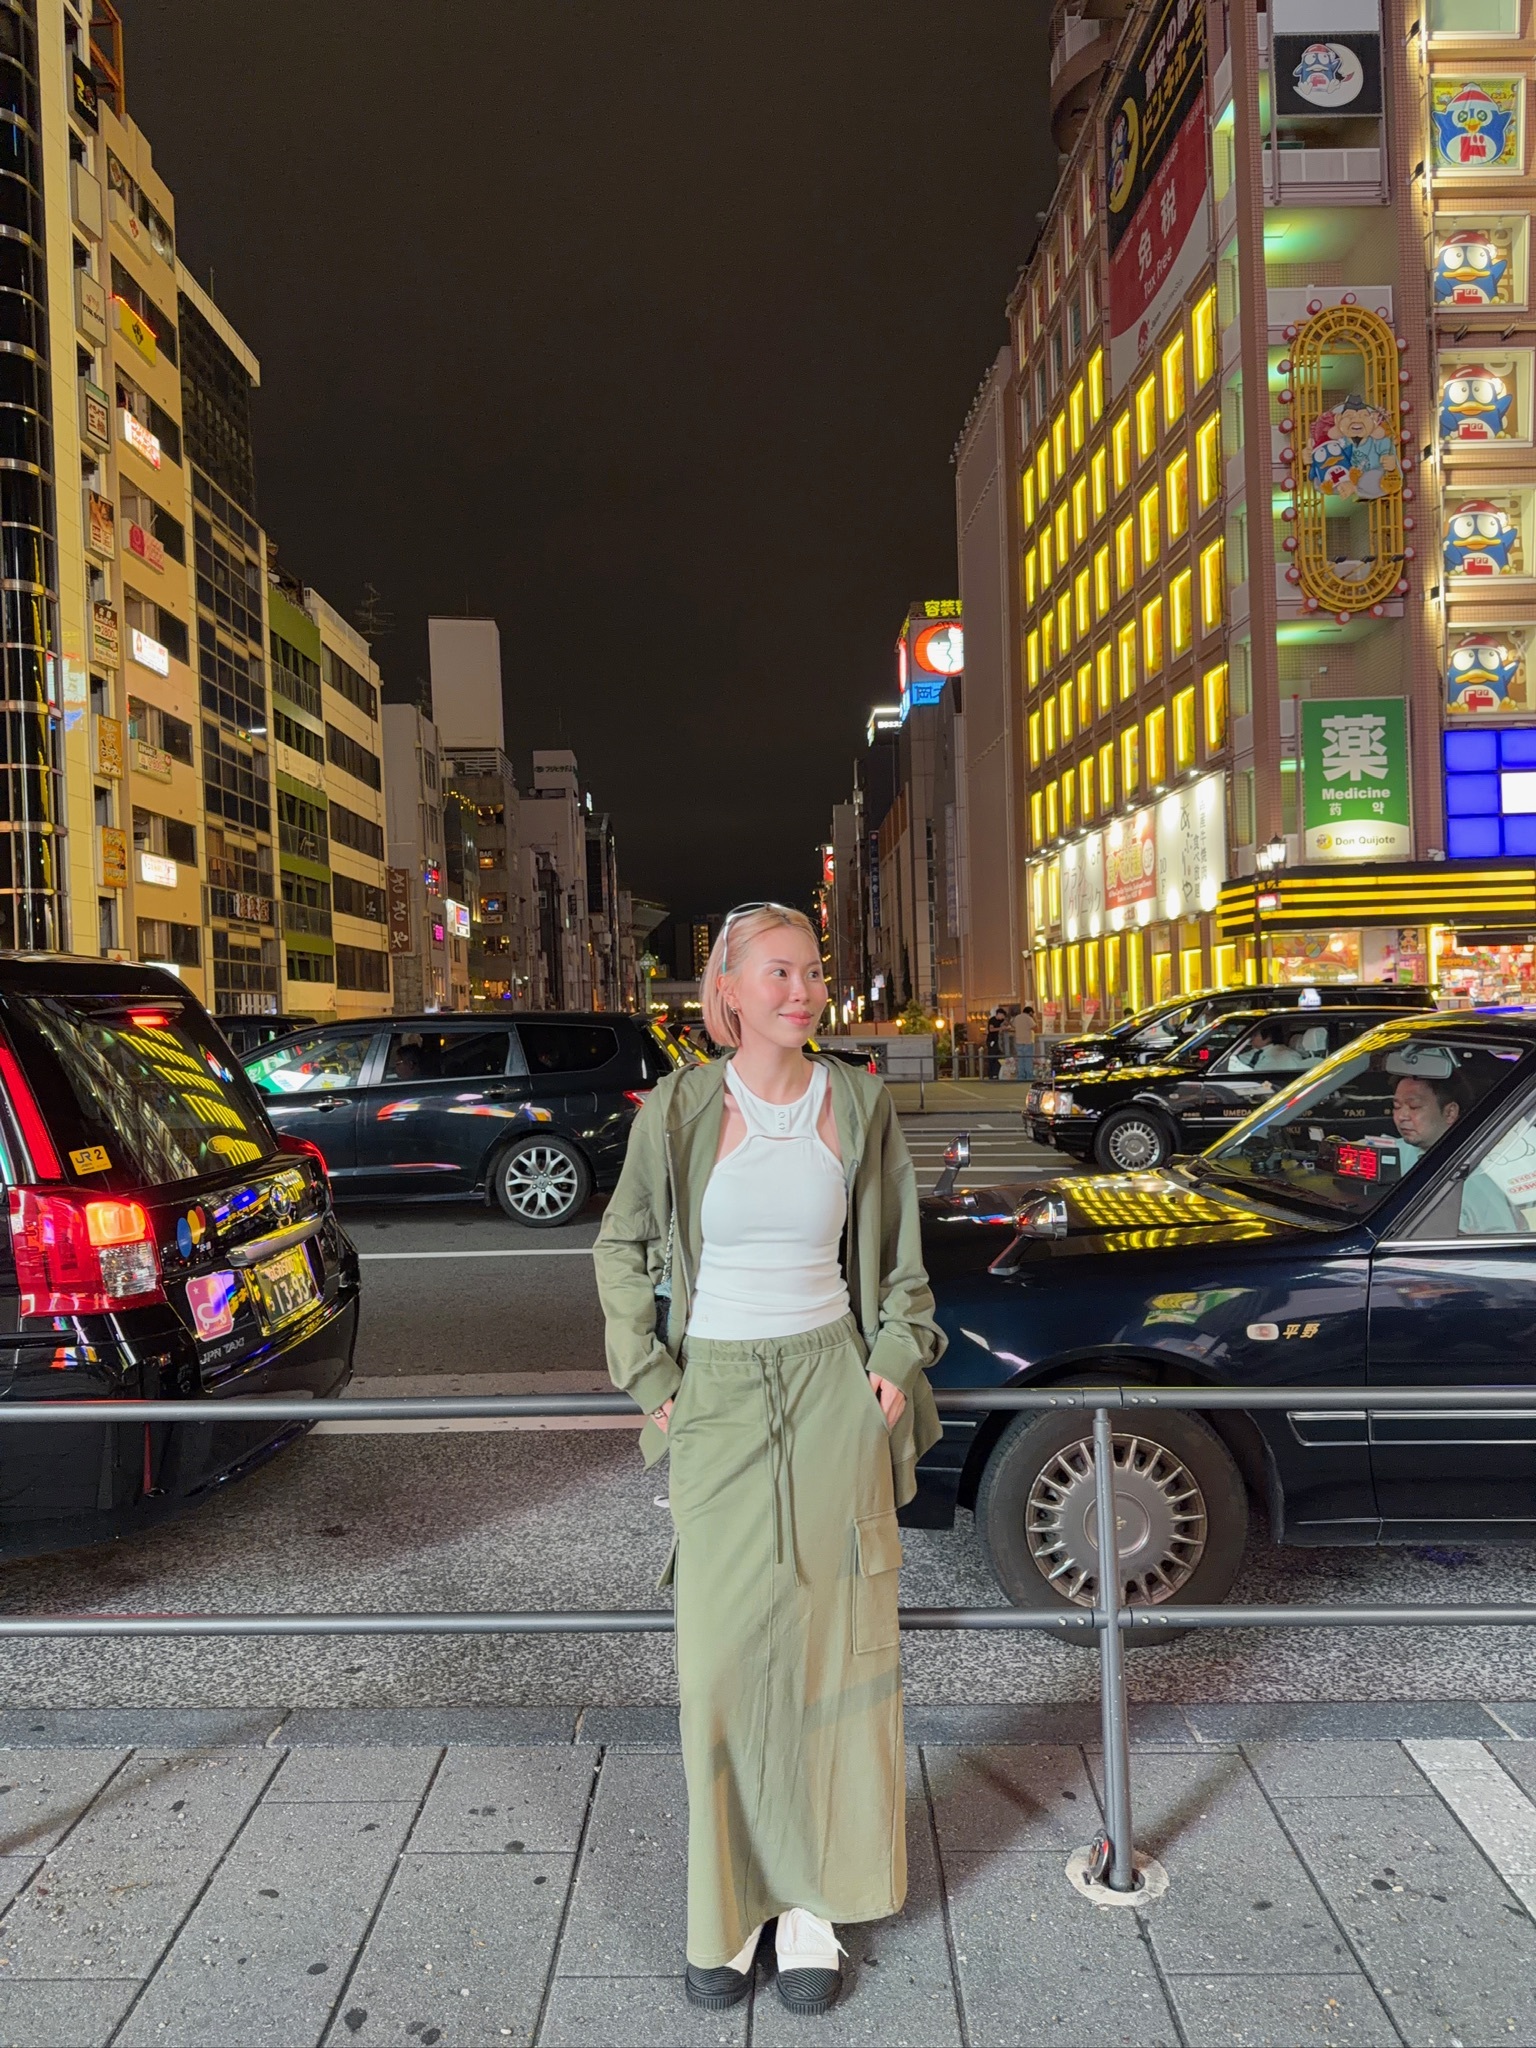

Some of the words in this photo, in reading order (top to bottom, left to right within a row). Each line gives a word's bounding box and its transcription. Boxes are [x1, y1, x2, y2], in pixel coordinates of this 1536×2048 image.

[1137, 178, 1177, 281] 免税
[1144, 275, 1157, 300] Tax
[1156, 245, 1173, 276] Free
[1321, 713, 1389, 782] 薬
[1321, 786, 1391, 801] Medicine
[1329, 802, 1342, 816] 药
[1372, 801, 1385, 815] 약
[1335, 836, 1355, 846] Don
[1358, 835, 1396, 846] Quijote
[1342, 1108, 1366, 1117] TAXI
[75, 1151, 92, 1164] JR
[93, 1148, 104, 1161] 2
[1338, 1144, 1378, 1181] 空車
[273, 1272, 310, 1315] 13-93
[1282, 1322, 1321, 1340] 平野
[200, 1347, 222, 1366] JPN
[222, 1336, 245, 1354] TAXI
